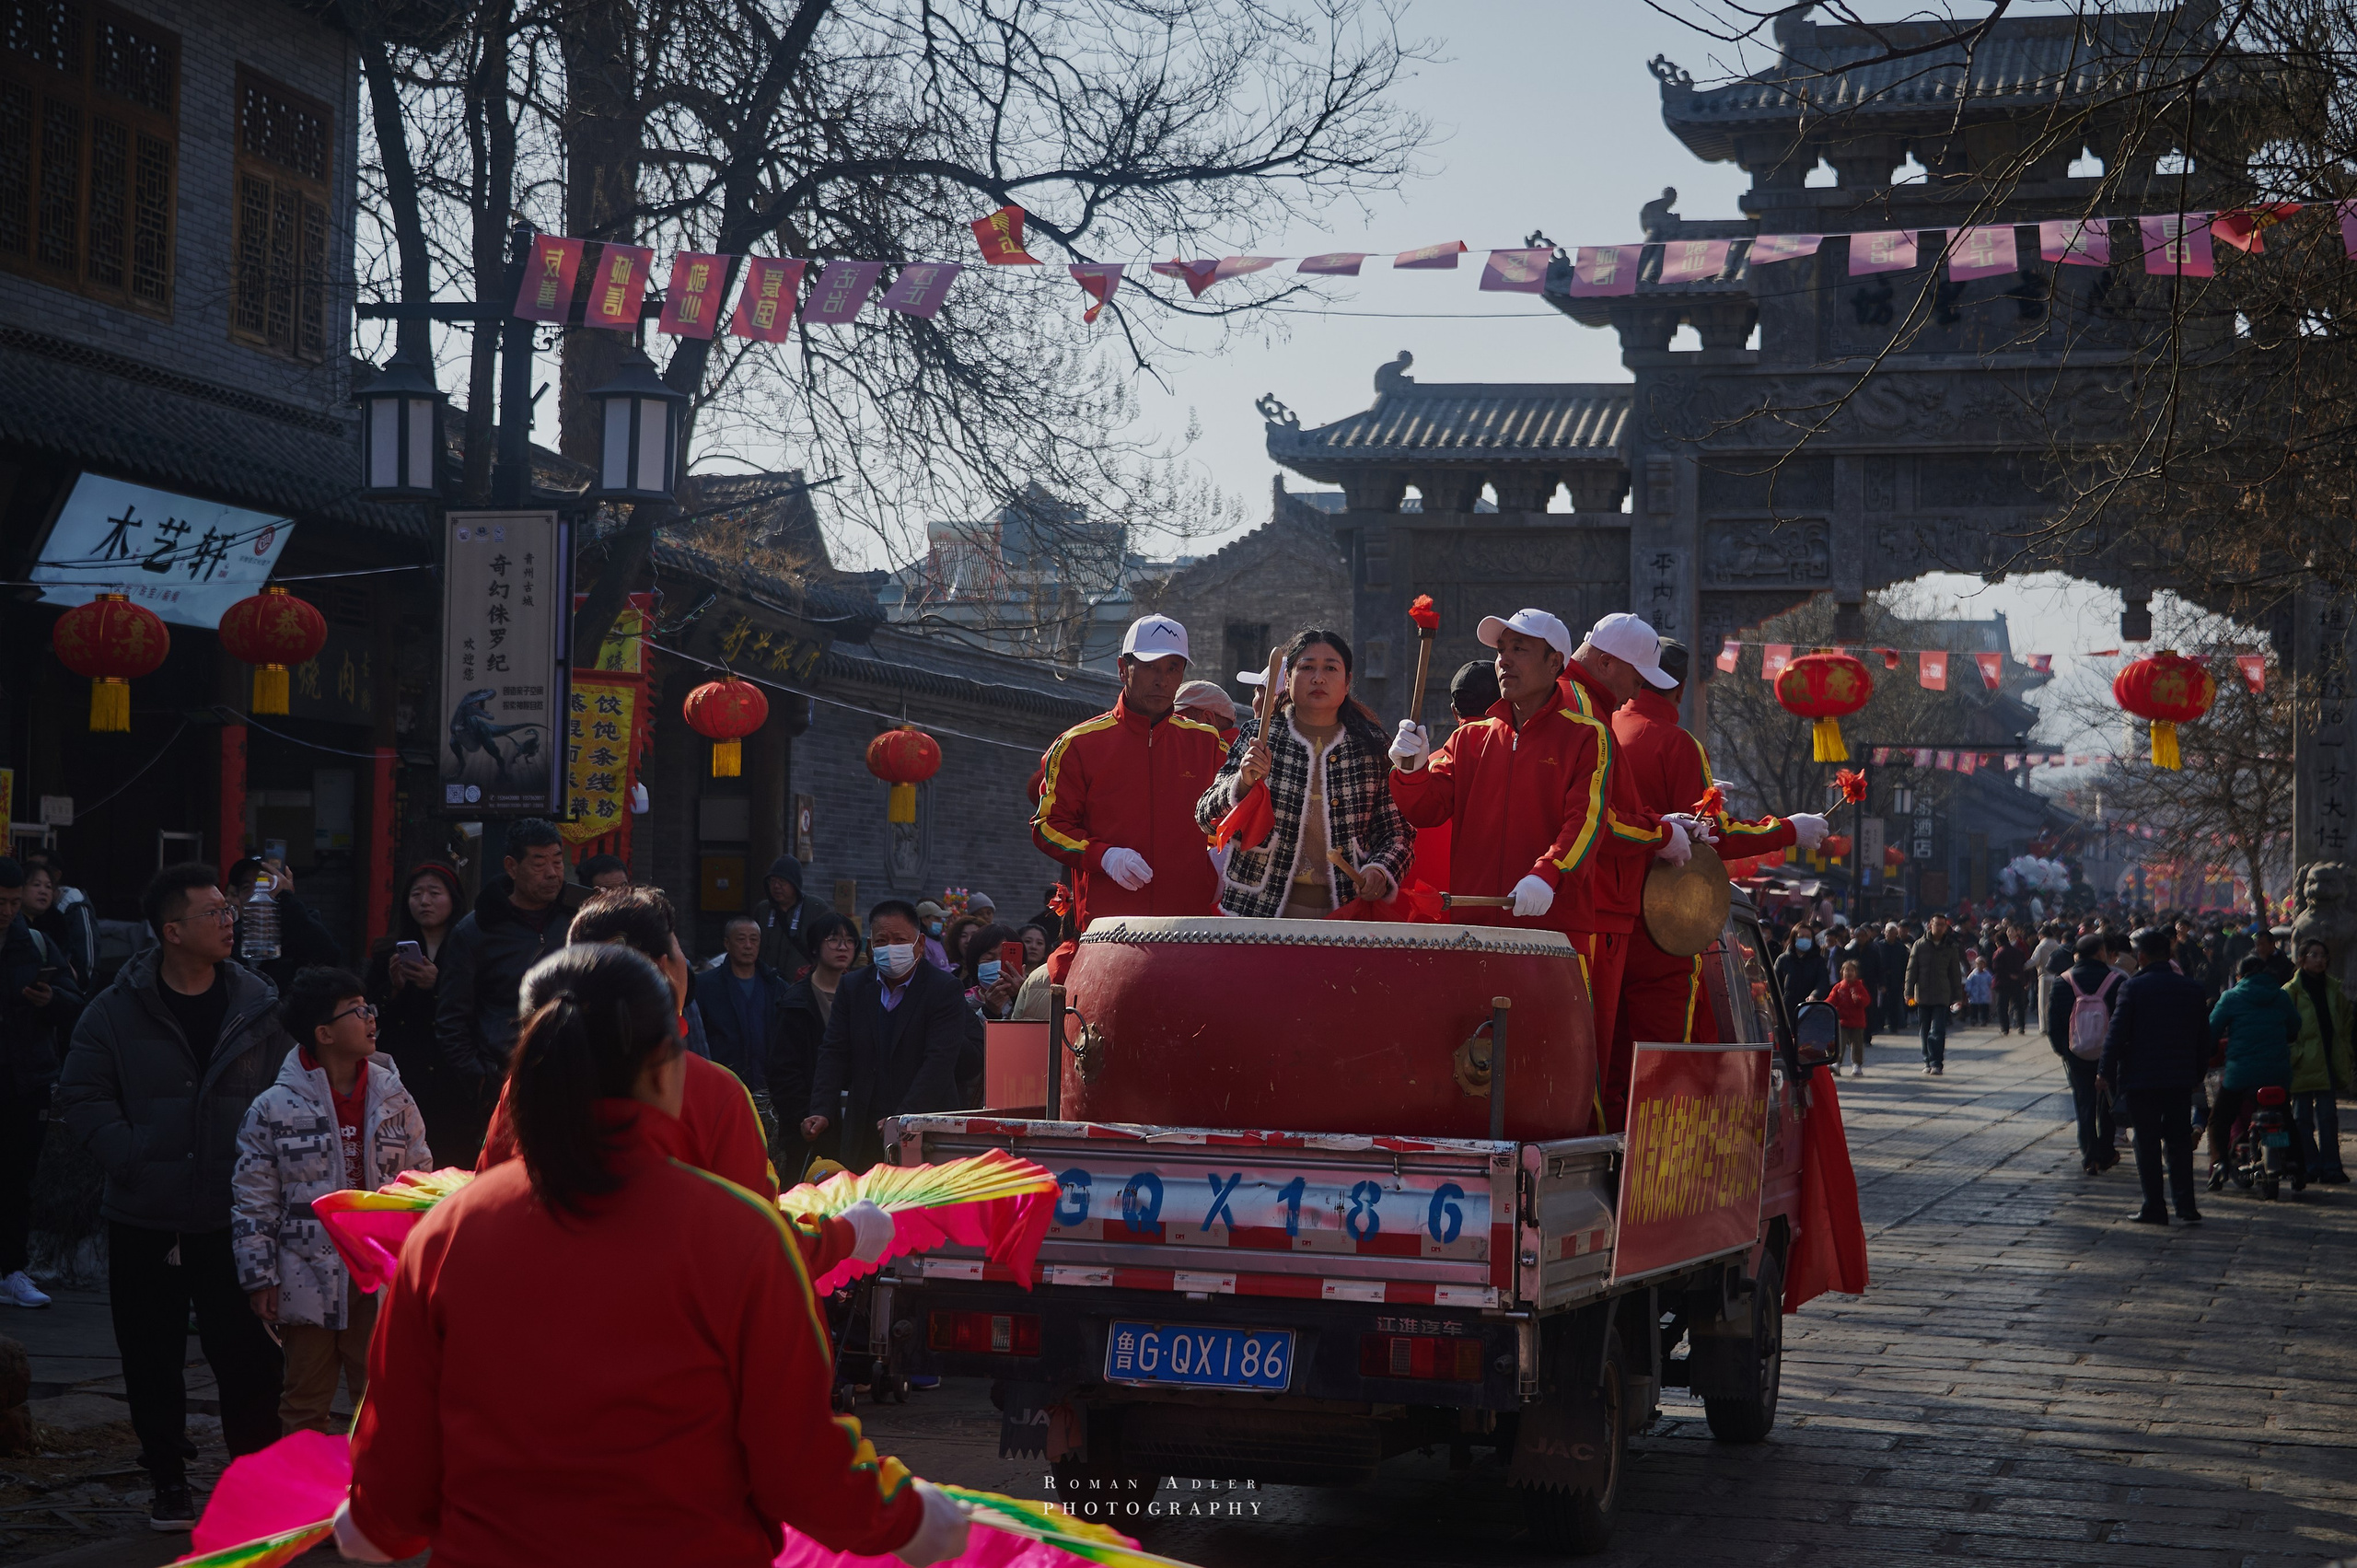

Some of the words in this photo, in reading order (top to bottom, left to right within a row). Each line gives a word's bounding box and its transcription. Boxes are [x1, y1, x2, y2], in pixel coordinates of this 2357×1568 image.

[90, 504, 237, 582] 木艺轩
[522, 552, 535, 608] 青州古城
[486, 552, 513, 672] 奇幻侏罗纪
[462, 638, 476, 681] 欢迎您
[1376, 1316, 1463, 1336] 江淮汽车
[1525, 1436, 1595, 1461] JAC
